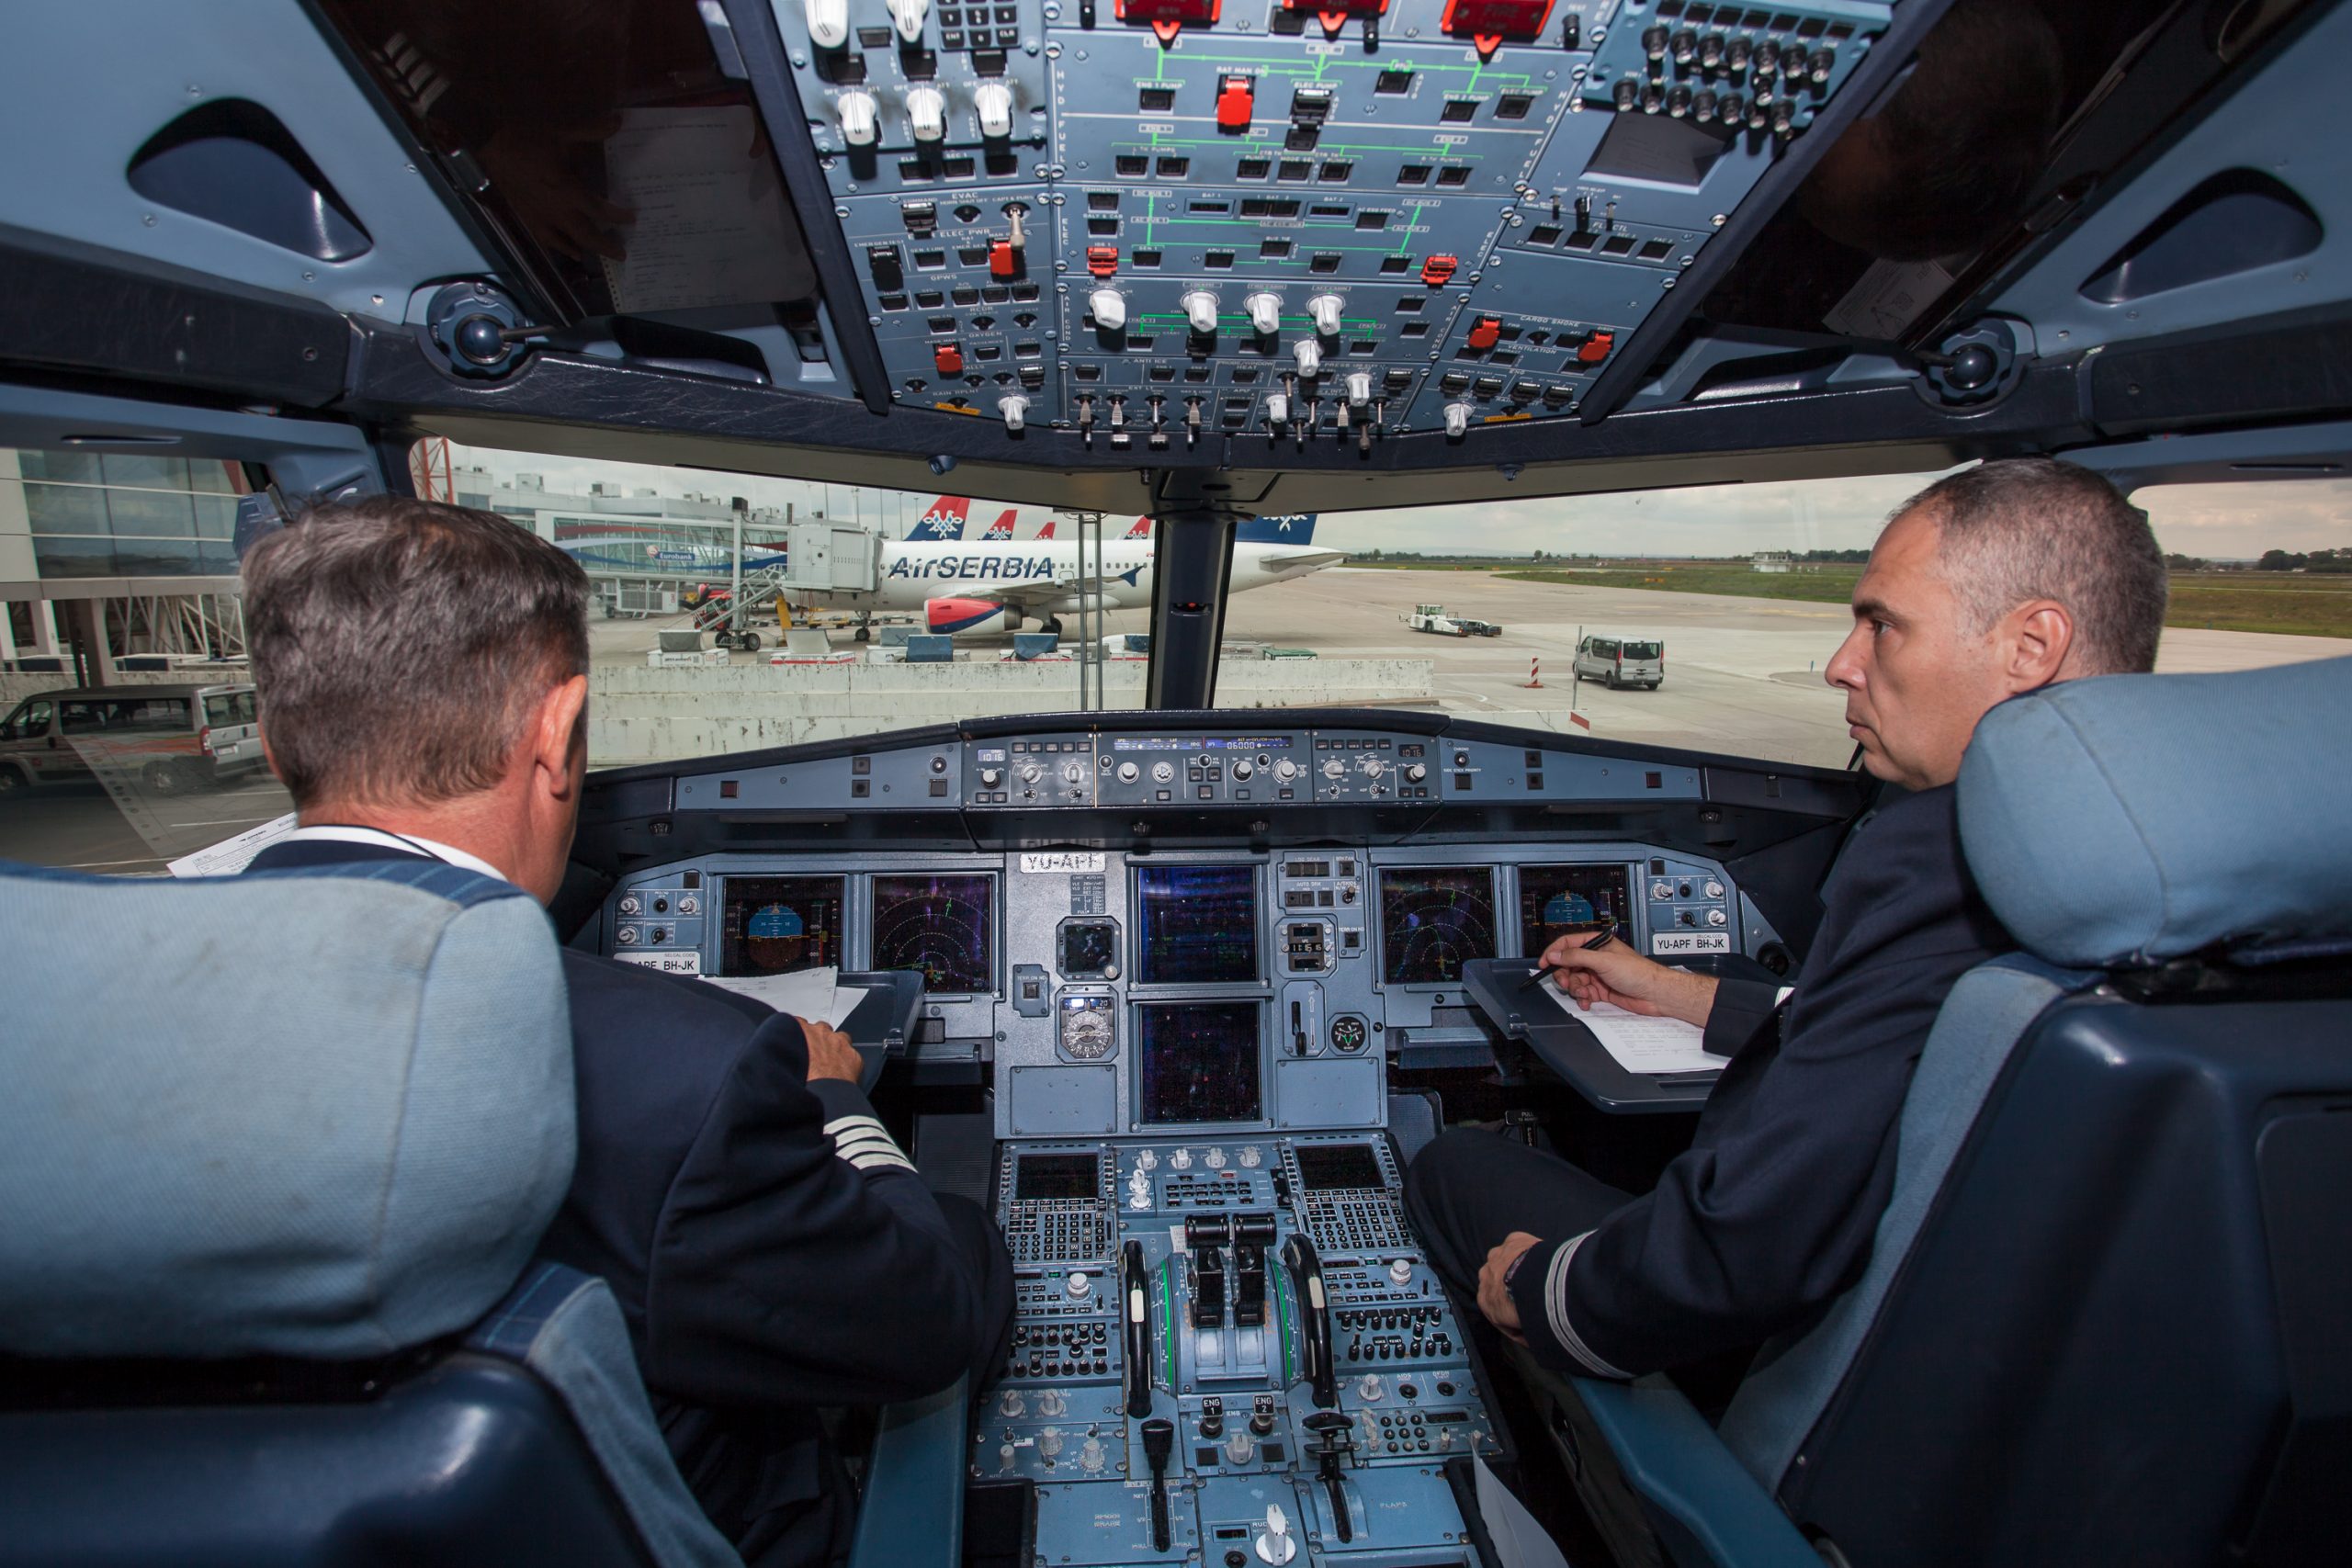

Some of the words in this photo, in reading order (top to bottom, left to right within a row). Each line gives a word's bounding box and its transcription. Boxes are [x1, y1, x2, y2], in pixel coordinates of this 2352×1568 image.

[1521, 315, 1549, 323] CARGO
[1552, 319, 1581, 328] SMOKE
[1508, 344, 1557, 355] VENTILATION
[888, 557, 1054, 579] AirSERBIA
[1657, 940, 1690, 949] YU-APF
[1697, 939, 1724, 948] BH-JK
[664, 961, 695, 970] BH-JK
[1204, 1398, 1220, 1407] ENG
[1255, 1397, 1272, 1405] ENG
